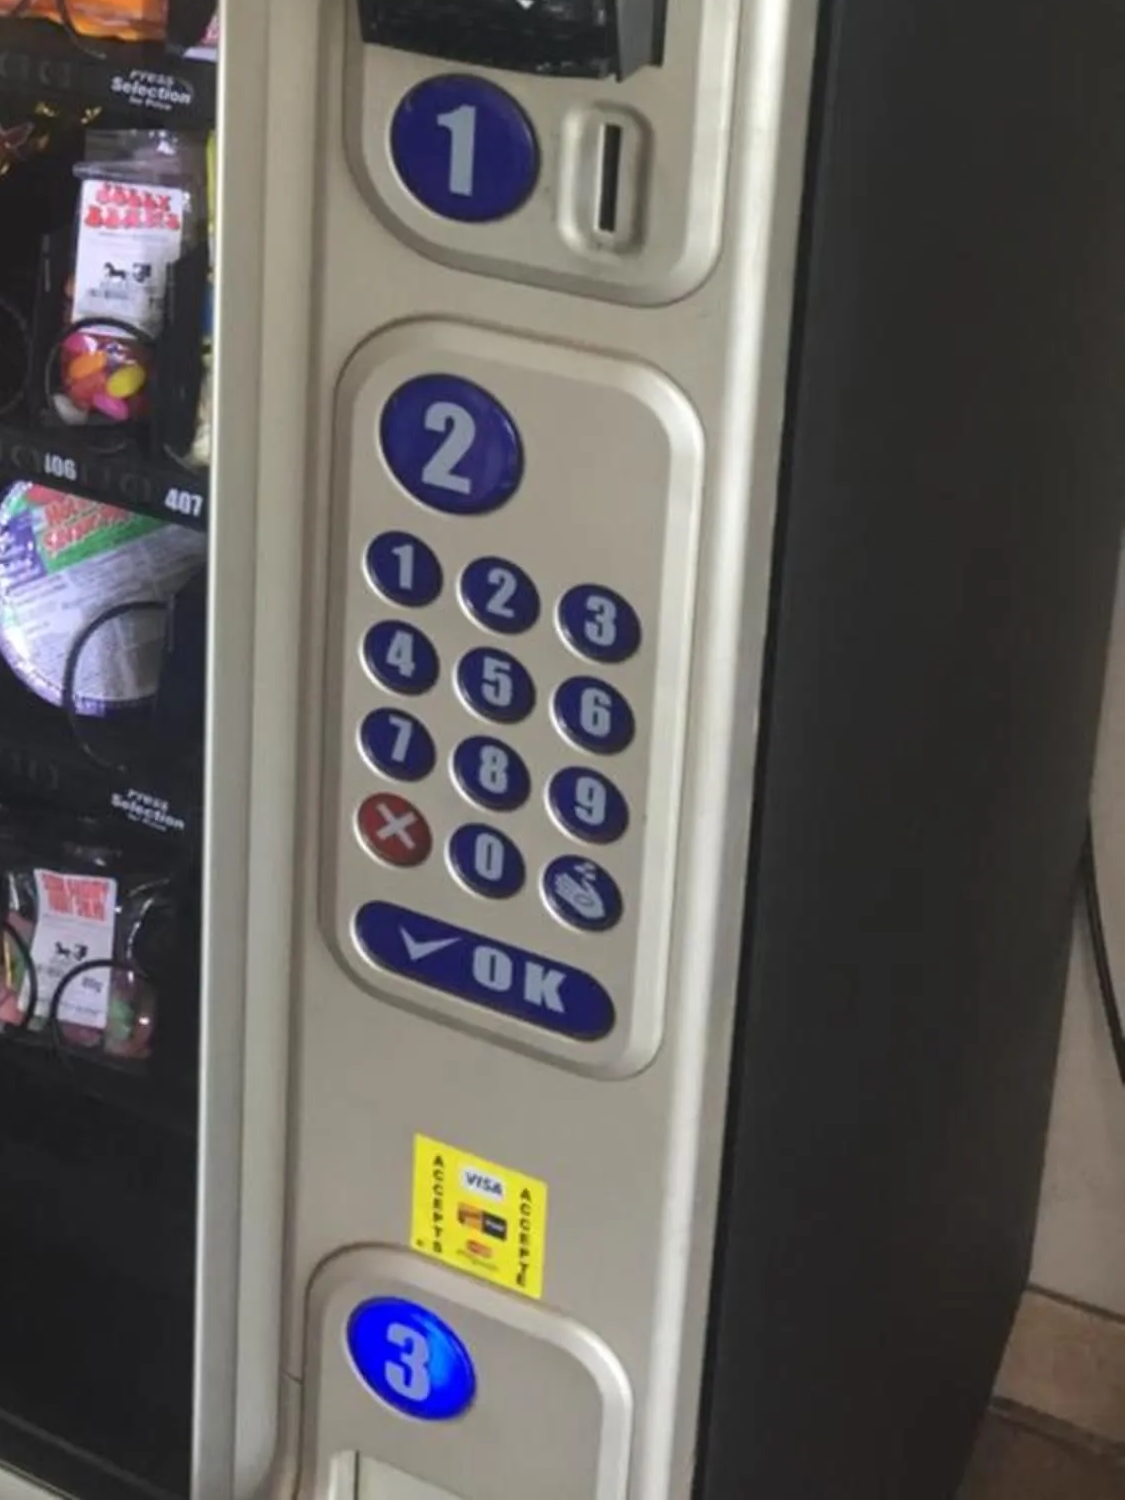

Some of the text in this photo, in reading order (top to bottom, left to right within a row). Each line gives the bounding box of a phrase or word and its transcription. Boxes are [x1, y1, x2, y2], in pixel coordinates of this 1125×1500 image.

[111, 76, 192, 105] Selection
[129, 69, 175, 86] Press
[437, 104, 477, 197] 1
[421, 400, 477, 495] 2
[165, 488, 204, 517] 407
[391, 544, 415, 591] 1
[485, 567, 517, 619] 2
[584, 595, 618, 647] 3
[385, 630, 416, 678] 4
[481, 656, 514, 708] 5
[579, 687, 613, 739] 6
[388, 714, 414, 764] 7
[478, 745, 509, 795] 8
[110, 793, 185, 830] Selection
[127, 788, 169, 812] Press
[575, 775, 607, 827] 9
[474, 832, 505, 882] 0
[472, 945, 568, 1014] OK
[432, 1155, 445, 1254] ACCEPTS
[464, 1170, 504, 1196] VISA
[384, 1322, 432, 1402] 3
